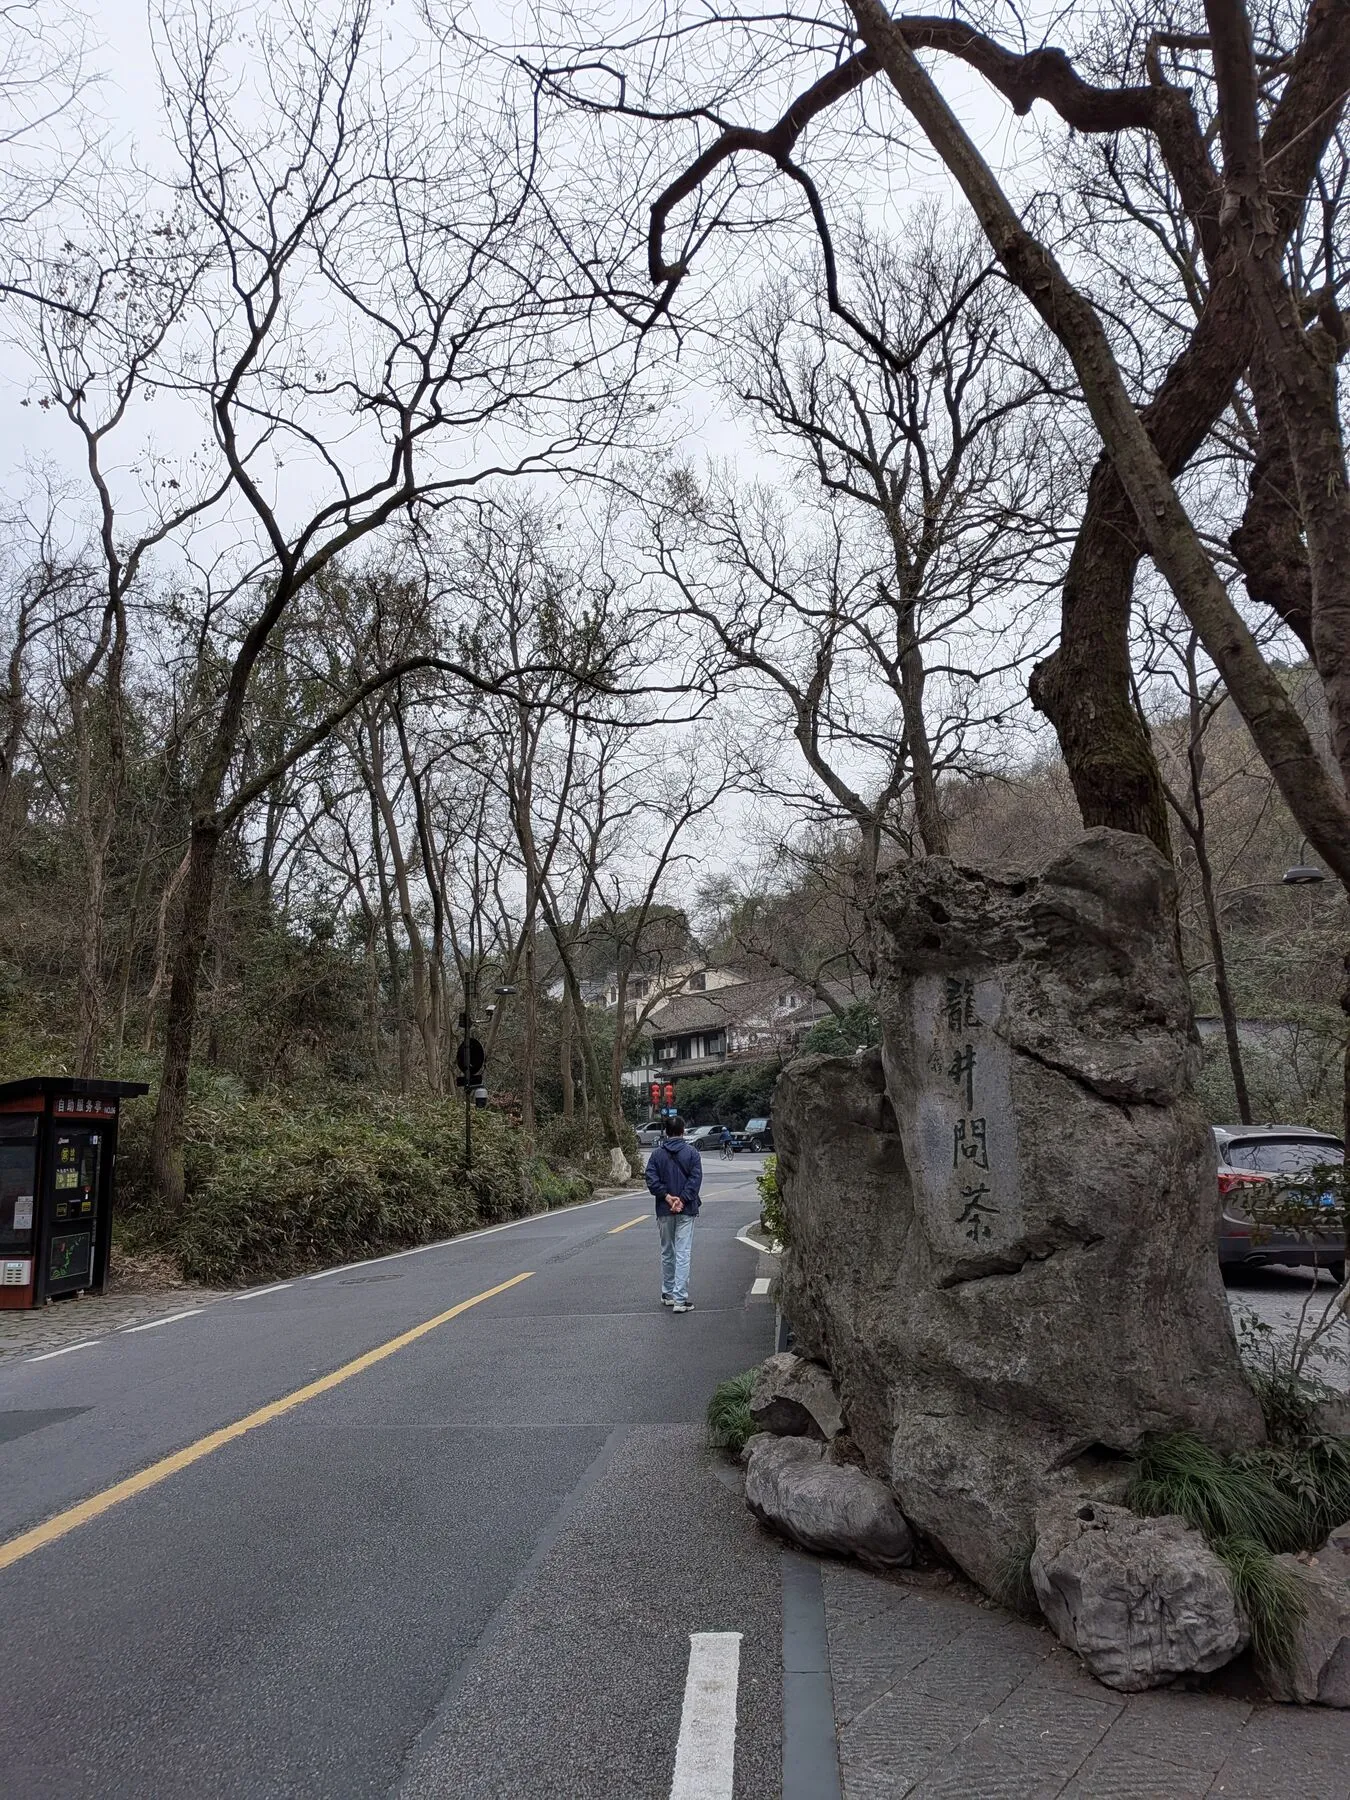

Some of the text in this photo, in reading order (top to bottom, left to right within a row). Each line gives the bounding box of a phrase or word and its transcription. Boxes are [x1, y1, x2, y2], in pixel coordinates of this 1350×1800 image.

[58, 1098, 102, 1113] 自助服务亭
